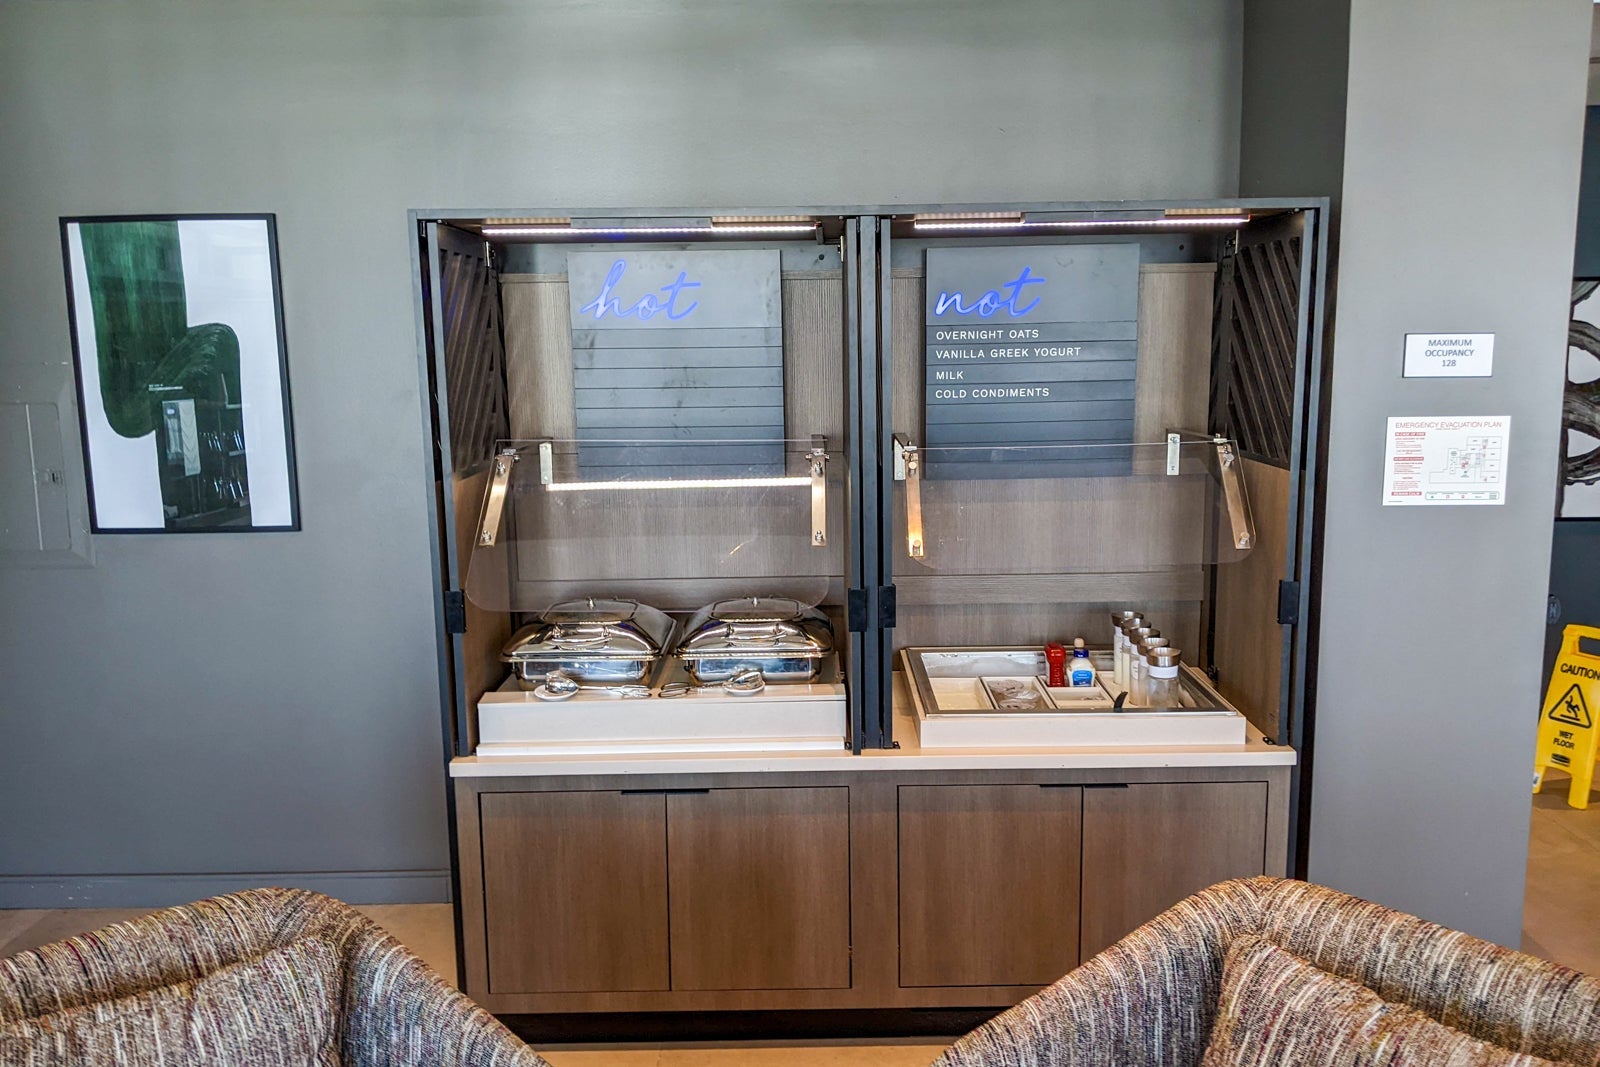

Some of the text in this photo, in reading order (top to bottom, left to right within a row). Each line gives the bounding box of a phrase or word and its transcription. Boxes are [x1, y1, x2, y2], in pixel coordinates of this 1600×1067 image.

[579, 258, 702, 321] hot
[934, 266, 1046, 318] not
[936, 329, 1040, 341] OVERNIGHT OATS
[1428, 339, 1472, 347] MAXIMUM
[935, 346, 1082, 360] VANILLA GREEK YOGURT
[1424, 349, 1474, 357] OCCUPANCY
[1442, 359, 1457, 367] 128
[936, 370, 964, 380] MILK
[935, 387, 1050, 399] COLD CONDIMENTS
[1395, 421, 1439, 429] EMERGENCY
[1440, 421, 1482, 429] EVACUATION
[1560, 662, 1600, 681] CAUTION
[1559, 730, 1574, 740] WET
[1553, 737, 1575, 750] FLOOR
